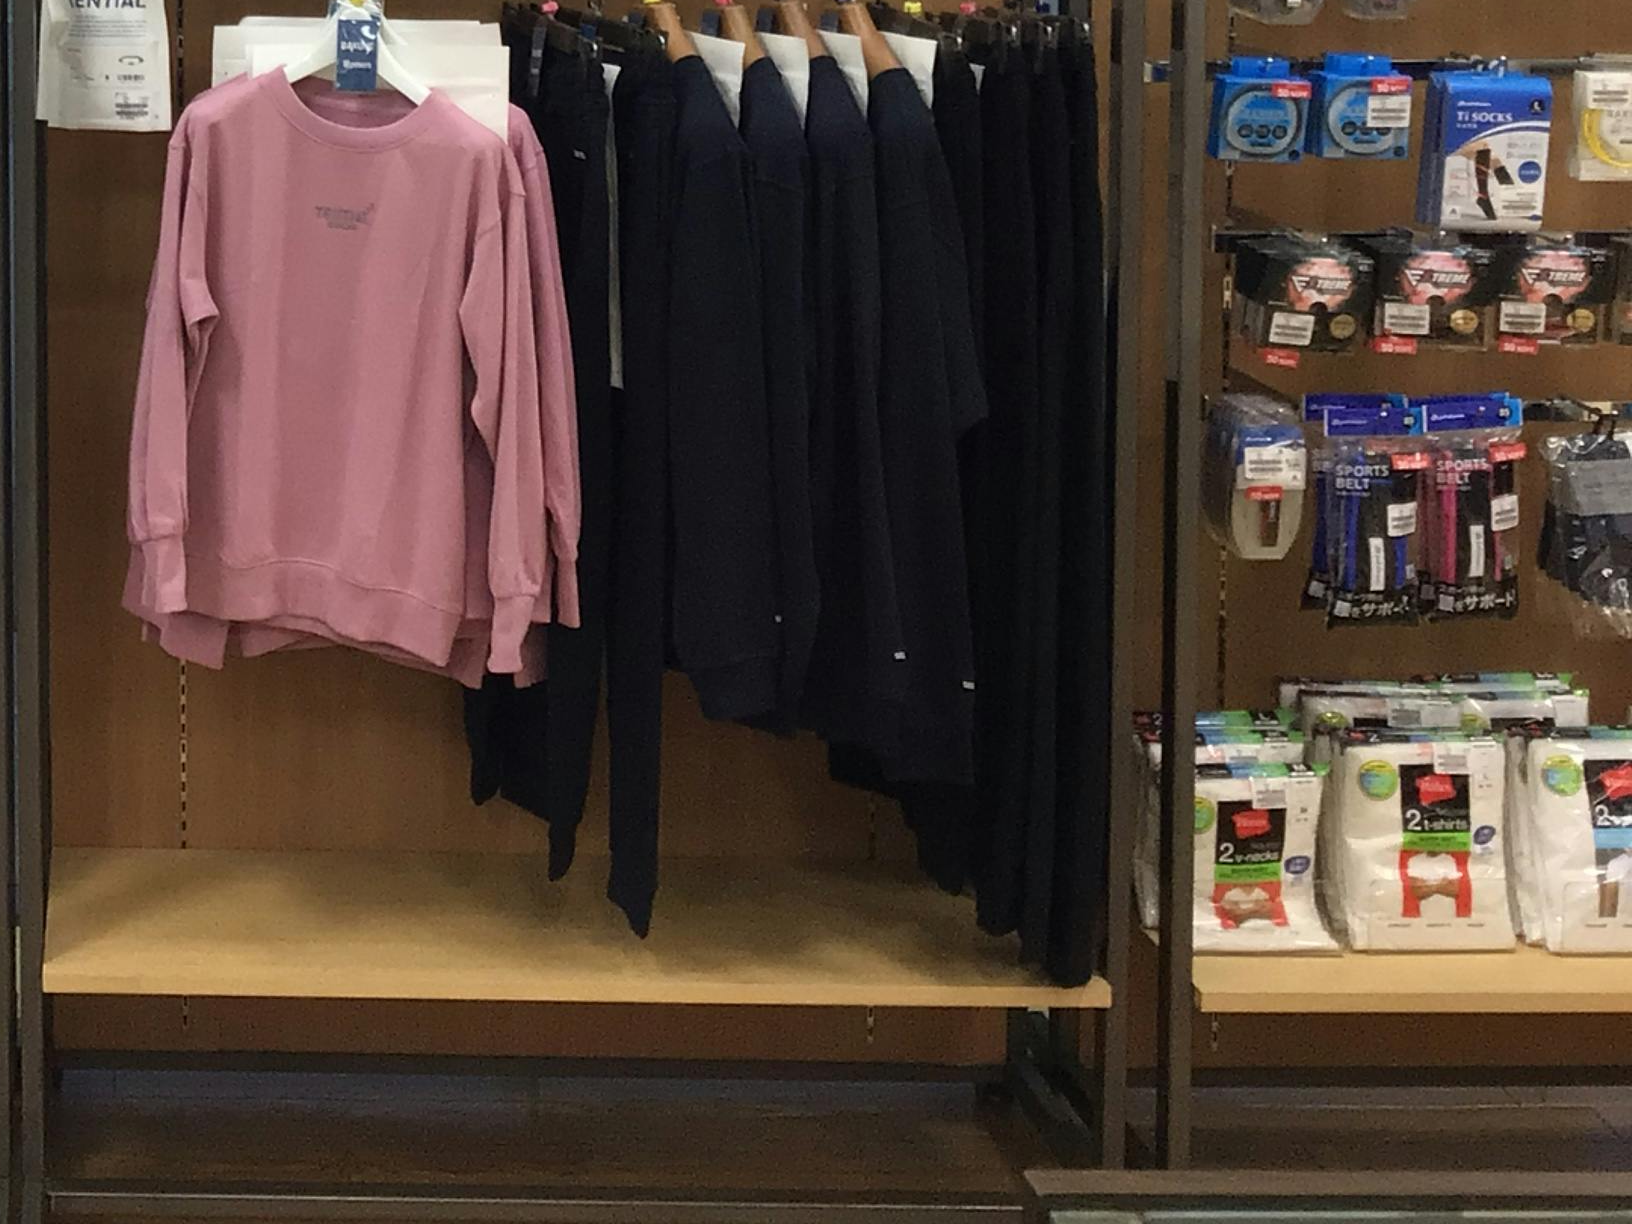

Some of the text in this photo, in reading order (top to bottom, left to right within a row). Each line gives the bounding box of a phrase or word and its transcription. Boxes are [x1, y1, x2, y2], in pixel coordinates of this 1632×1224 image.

[1472, 112, 1514, 122] SOCKS
[1335, 465, 1390, 477] SPORTS
[1436, 458, 1488, 472] SPORTS
[1335, 478, 1370, 489] BELT
[1436, 472, 1471, 484] BELT
[1405, 809, 1423, 830] 2
[1219, 842, 1235, 863] 2
